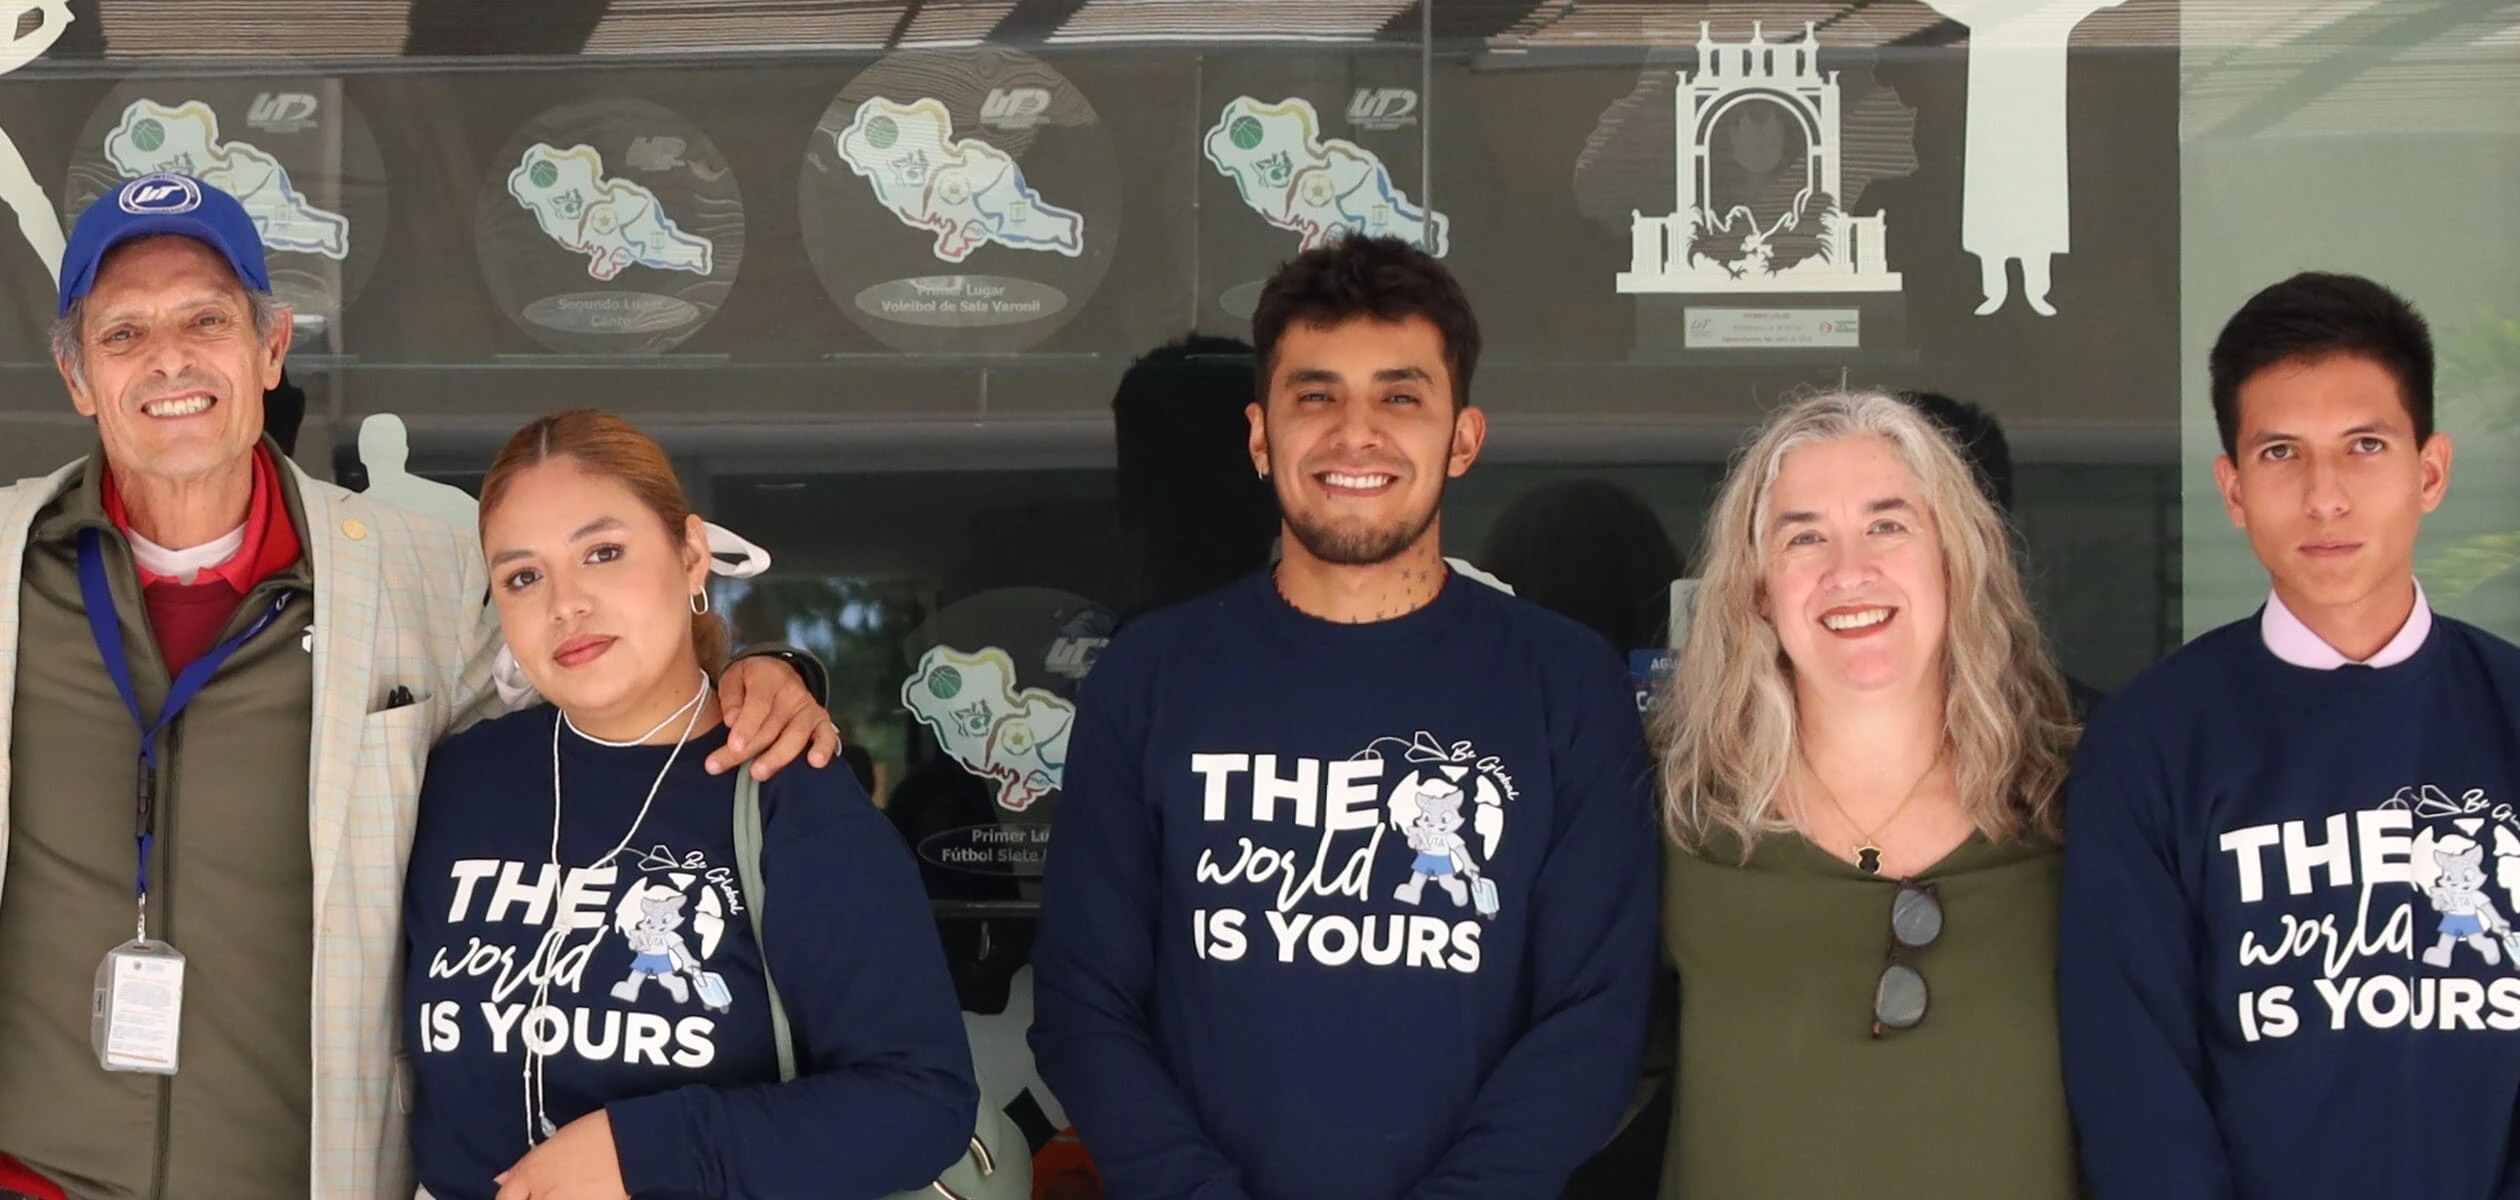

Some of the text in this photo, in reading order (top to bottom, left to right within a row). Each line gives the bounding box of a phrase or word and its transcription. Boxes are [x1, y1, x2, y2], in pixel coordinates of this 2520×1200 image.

[882, 300, 1041, 313] Voleibol de Sala Varonil
[966, 283, 1007, 298] Lugar
[1191, 753, 1384, 831] THE
[1451, 740, 1520, 801] Be Global
[2462, 788, 2491, 814] Be
[942, 846, 993, 863] Fútbol
[997, 847, 1039, 863] Siete
[971, 829, 1026, 843] Primer
[1196, 822, 1386, 913] world
[2219, 809, 2413, 903] THE
[447, 858, 619, 930] THE
[681, 850, 744, 916] Be Global
[429, 924, 609, 1001] world
[1193, 908, 1482, 974] IS YOURS
[420, 999, 716, 1068] IS YOURS
[2238, 974, 2520, 1042] IS YOURS
